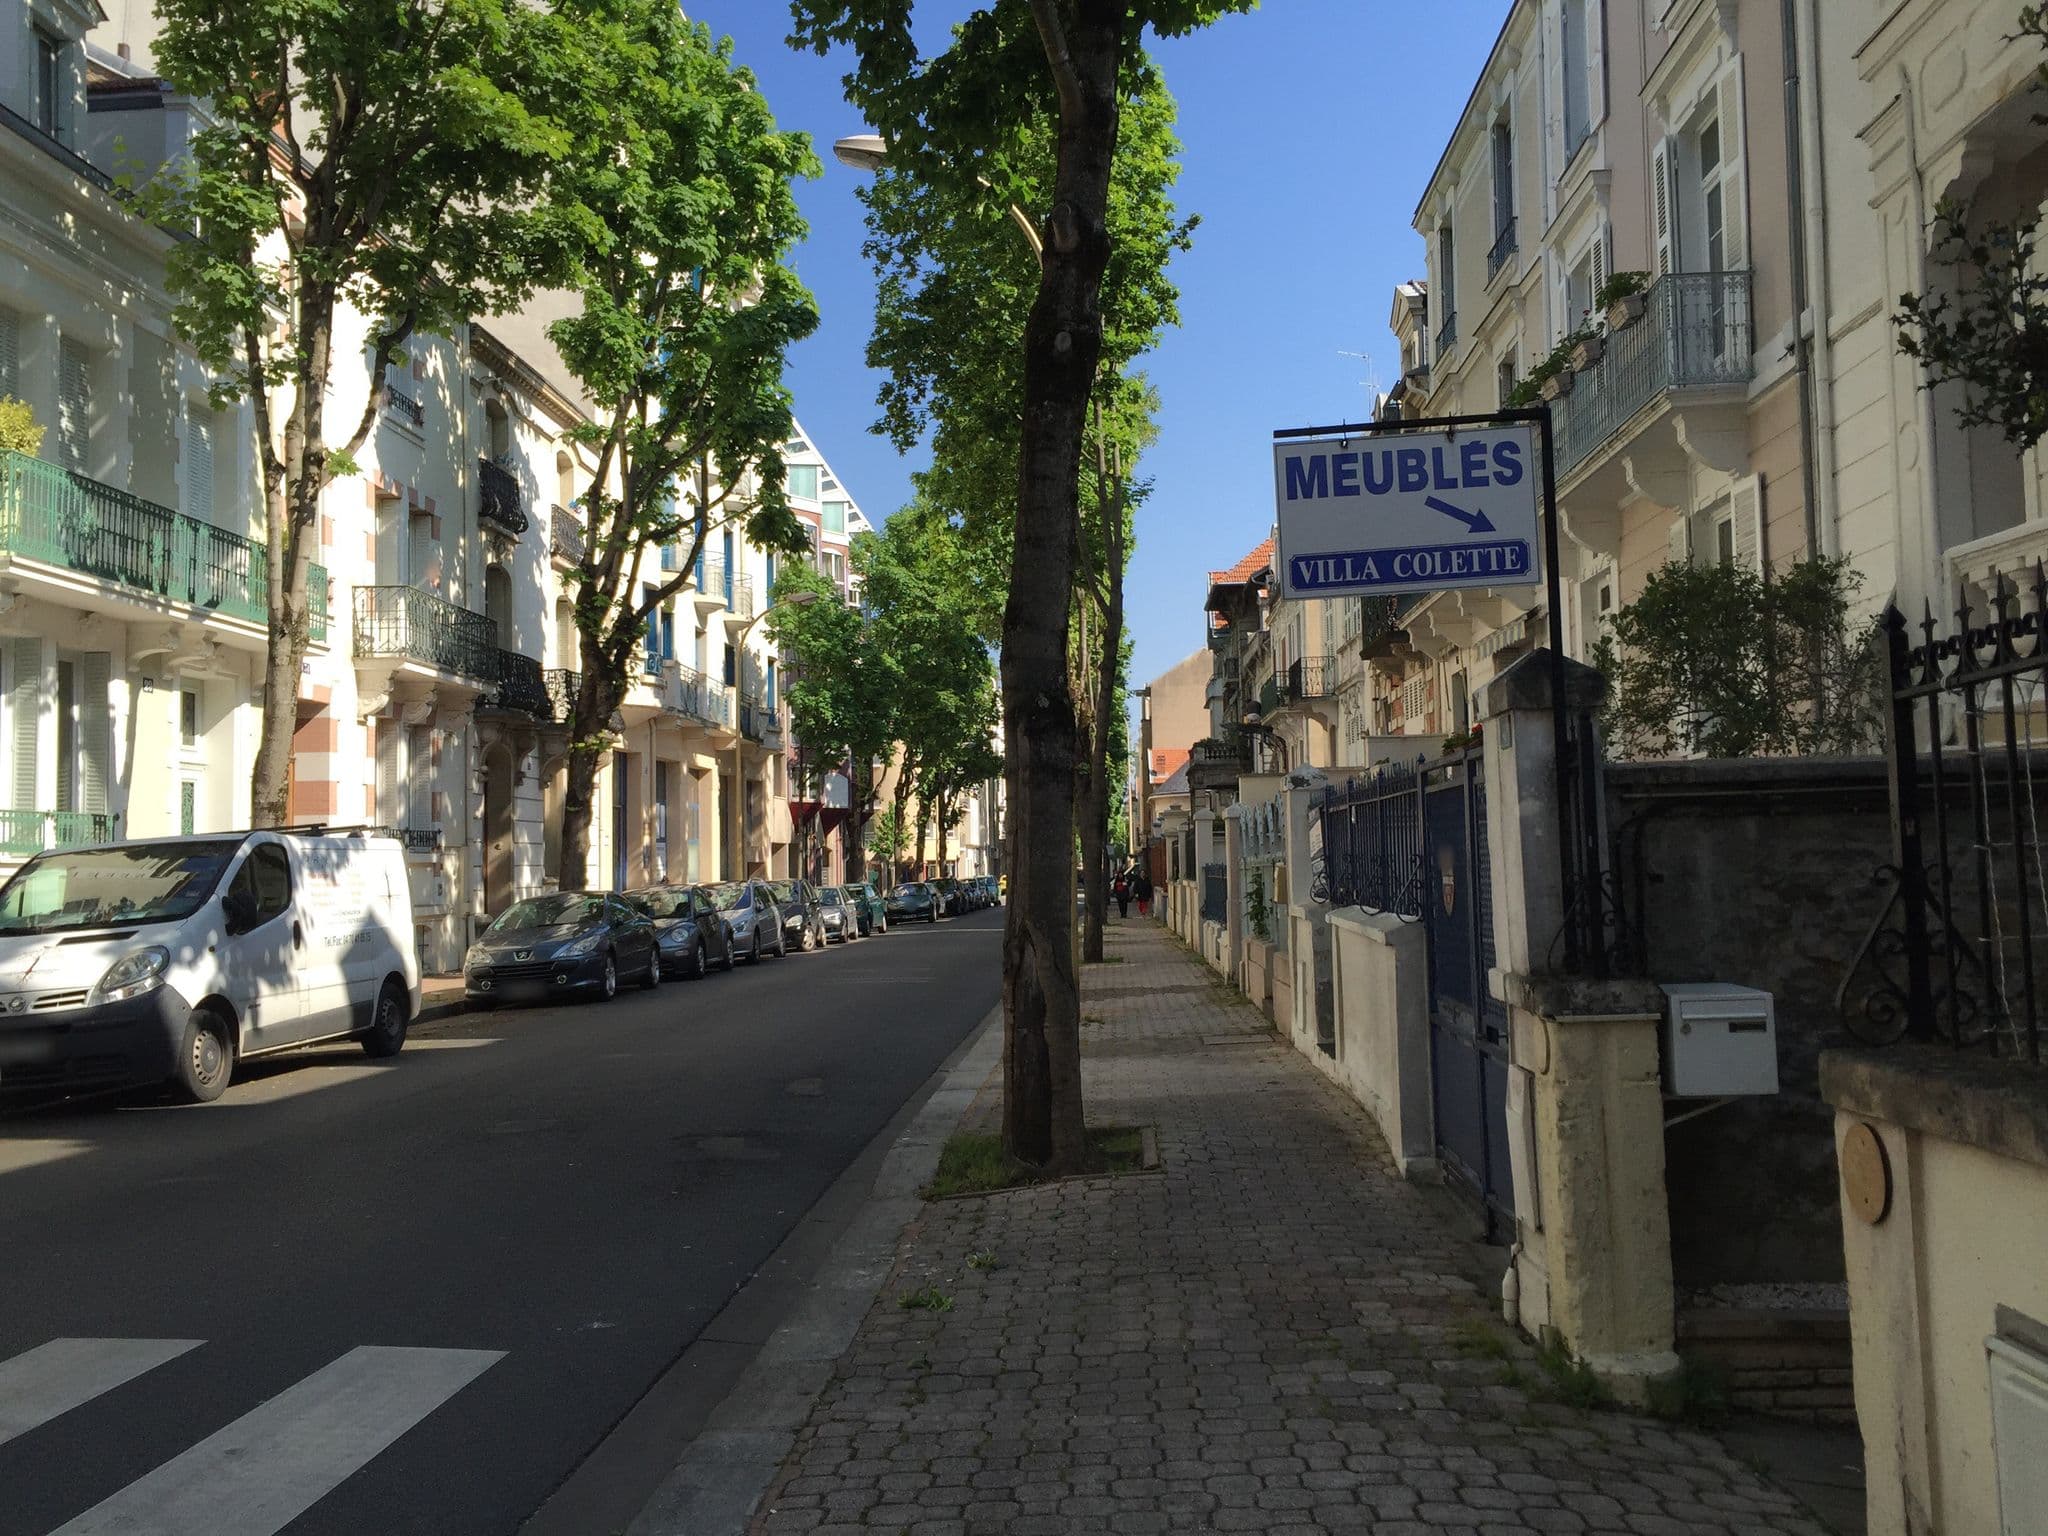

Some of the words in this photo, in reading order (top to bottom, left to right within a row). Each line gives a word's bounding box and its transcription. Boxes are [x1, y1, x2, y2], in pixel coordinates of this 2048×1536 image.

[1285, 440, 1524, 500] MEUBLÉS
[1298, 556, 1380, 585] VILLA
[1393, 546, 1521, 578] COLETTE
